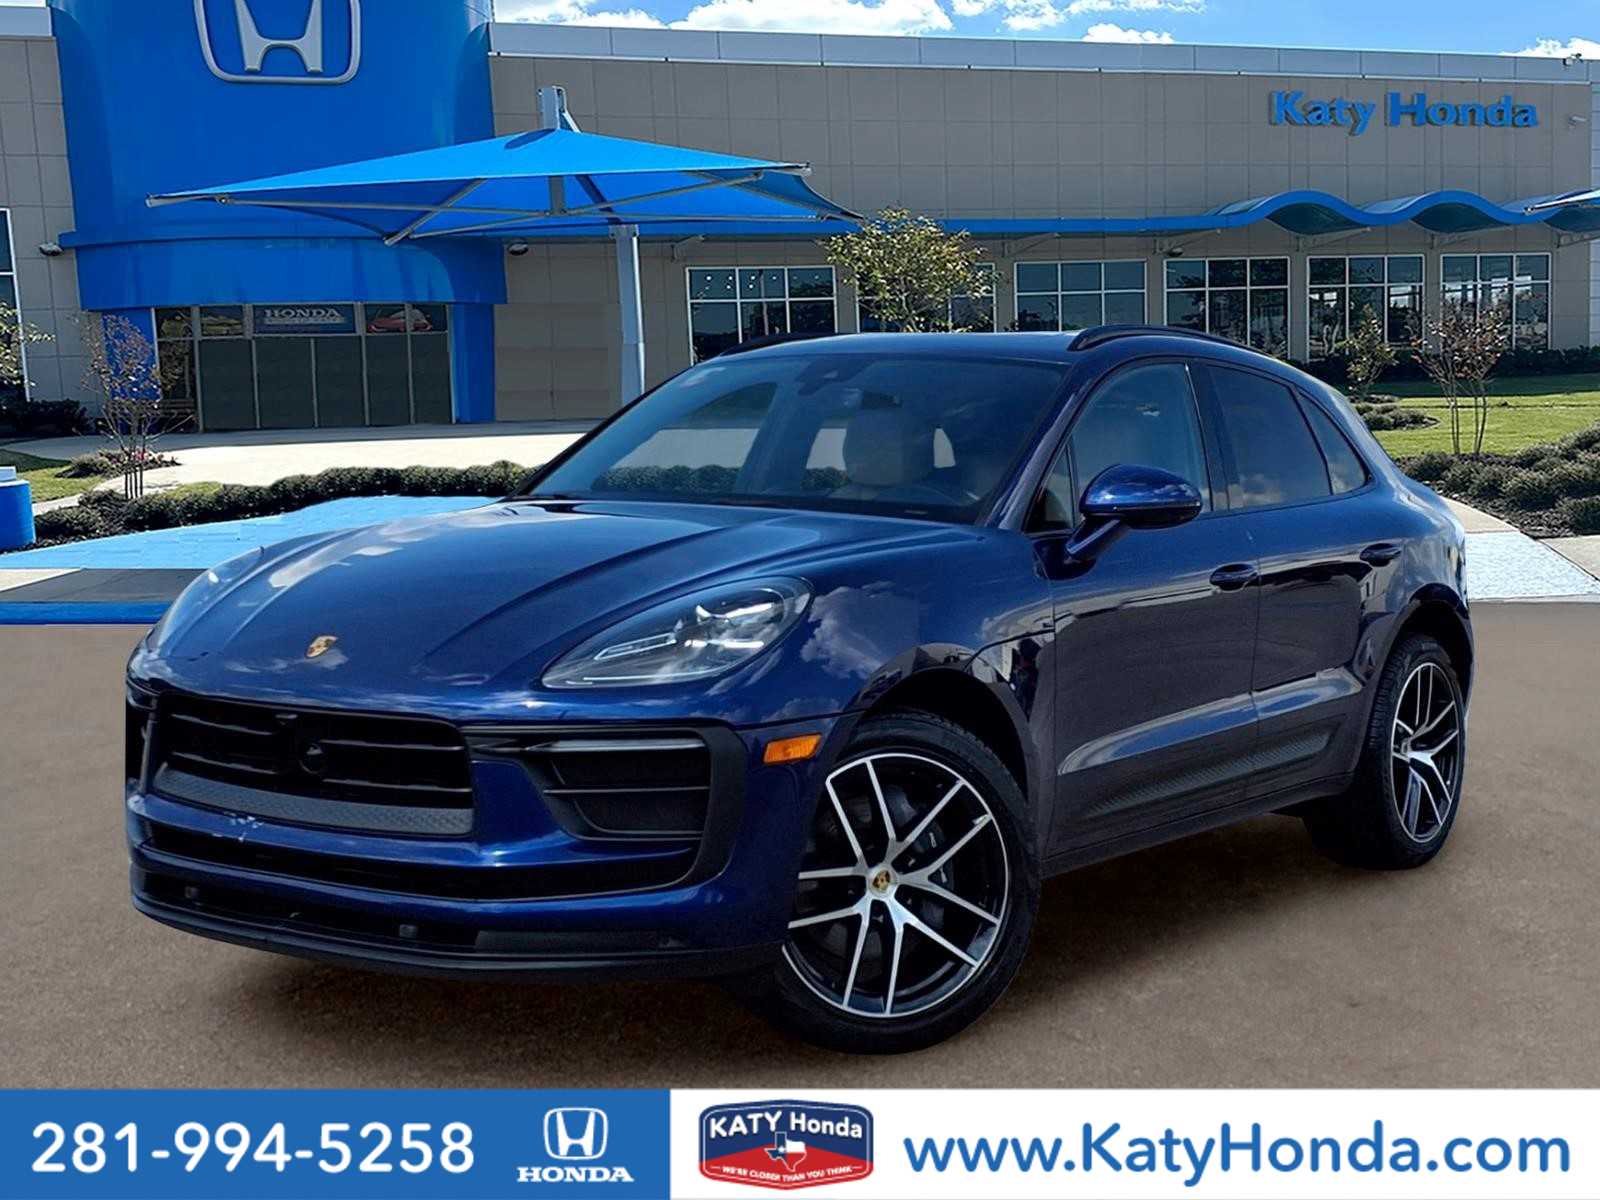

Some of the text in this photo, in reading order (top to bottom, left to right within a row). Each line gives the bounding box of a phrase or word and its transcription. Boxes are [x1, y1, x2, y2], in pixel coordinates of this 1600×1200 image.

[1270, 90, 1539, 136] Katy Honda
[264, 308, 342, 318] HONDA
